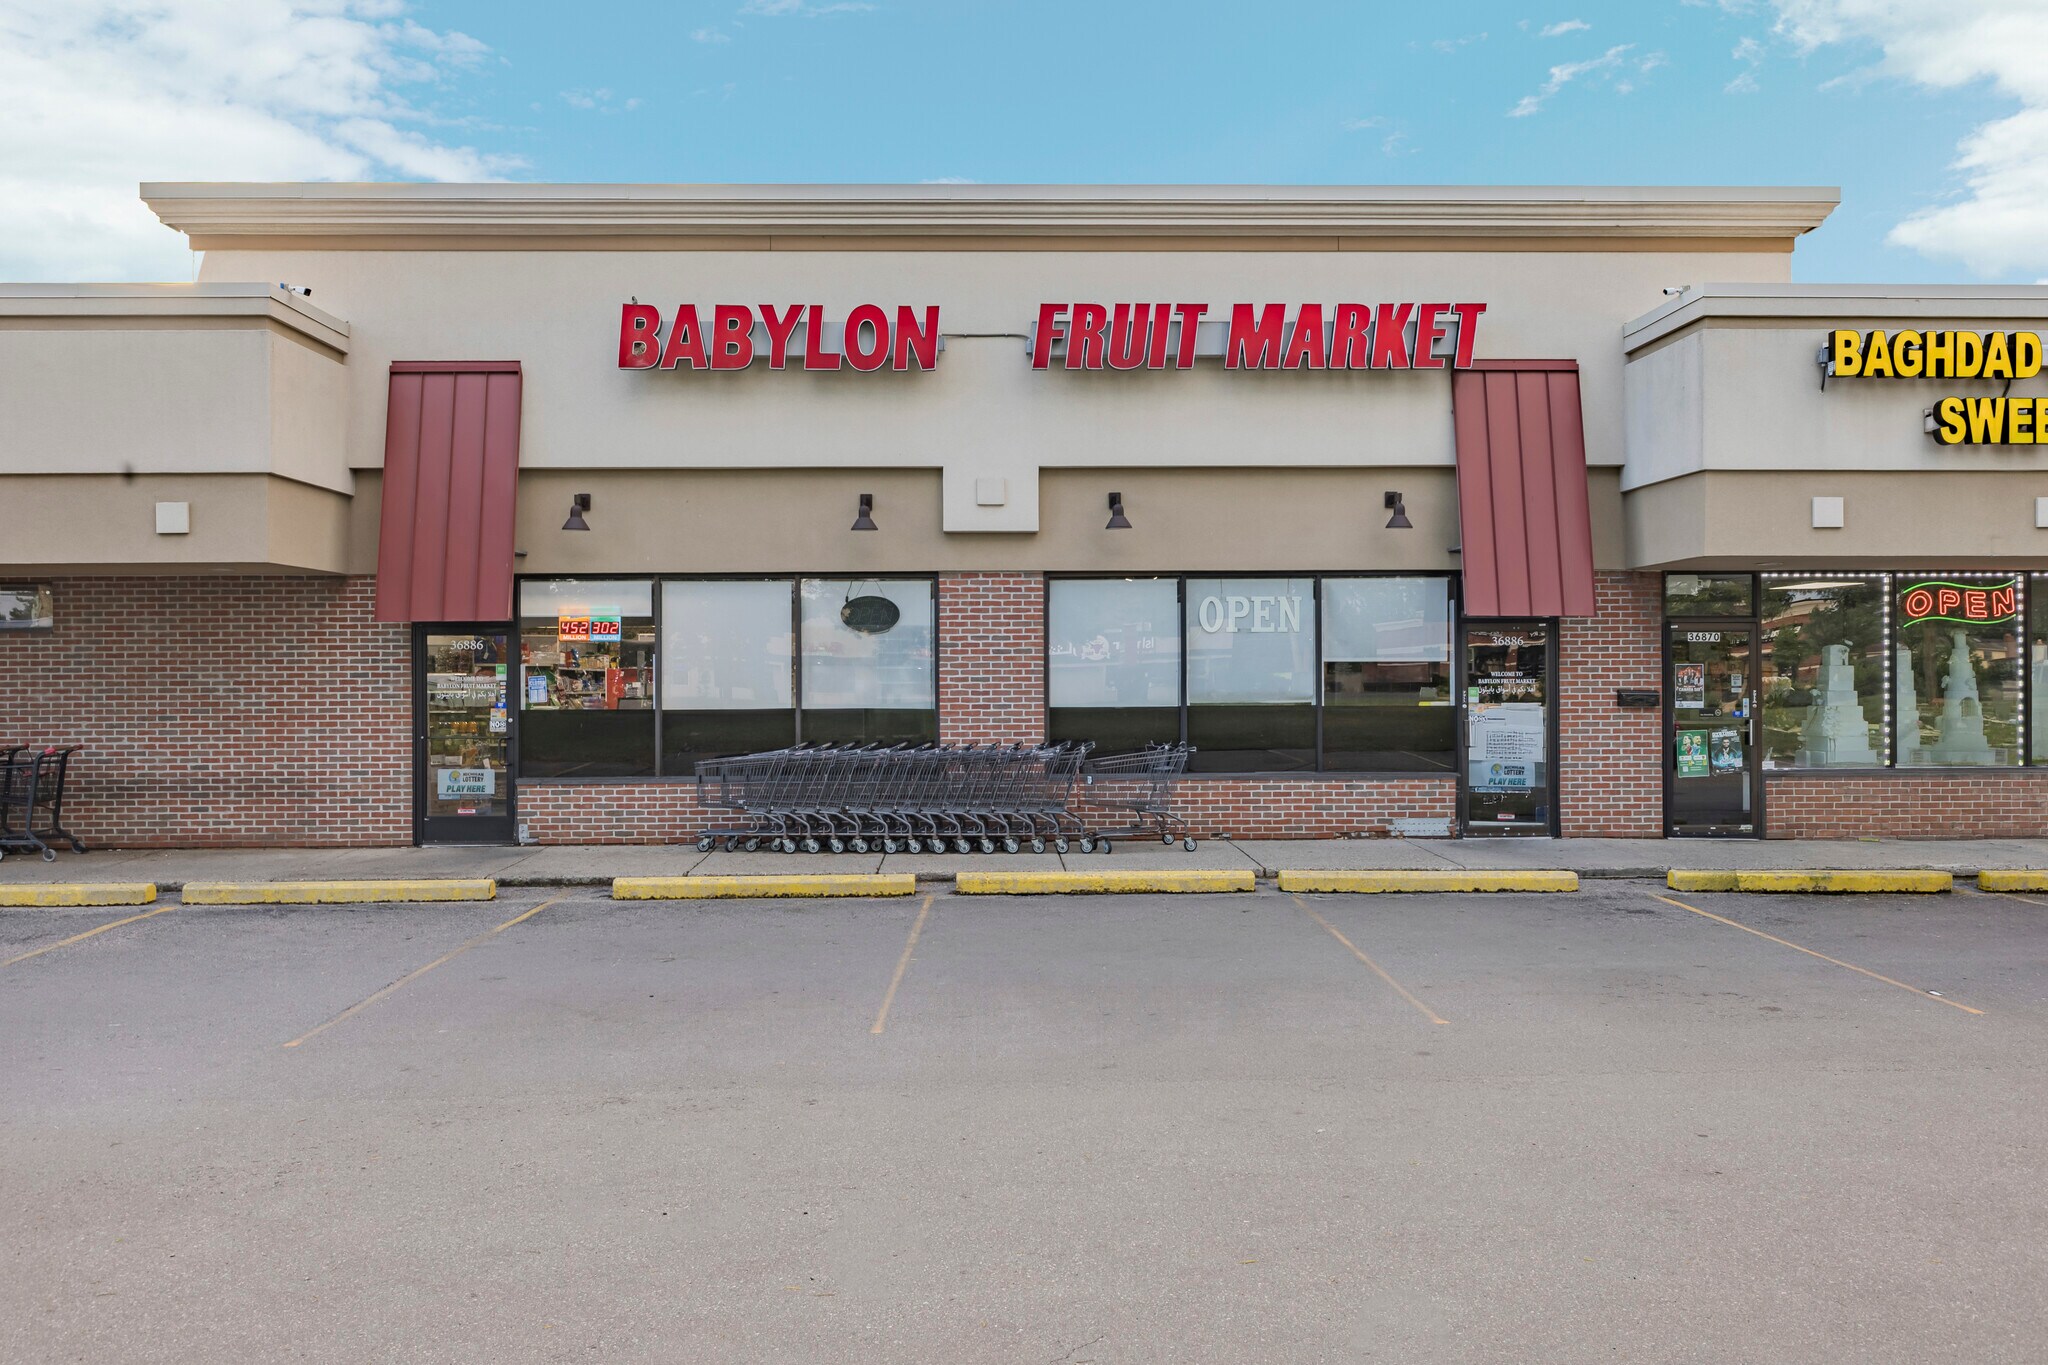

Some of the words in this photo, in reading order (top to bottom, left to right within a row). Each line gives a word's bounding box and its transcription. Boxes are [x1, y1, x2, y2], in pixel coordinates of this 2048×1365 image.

[617, 303, 940, 372] BABYLON
[1031, 303, 1208, 370] FRUIT
[1224, 303, 1488, 370] MARKET
[1829, 329, 2043, 379] BAGHDAD
[1906, 587, 2016, 618] OPEN
[1199, 596, 1303, 633] OPEN
[561, 621, 589, 634] 452
[592, 621, 619, 634] 302
[1688, 632, 1720, 641] 36870
[450, 640, 484, 650] 36886
[1491, 636, 1524, 646] 36886
